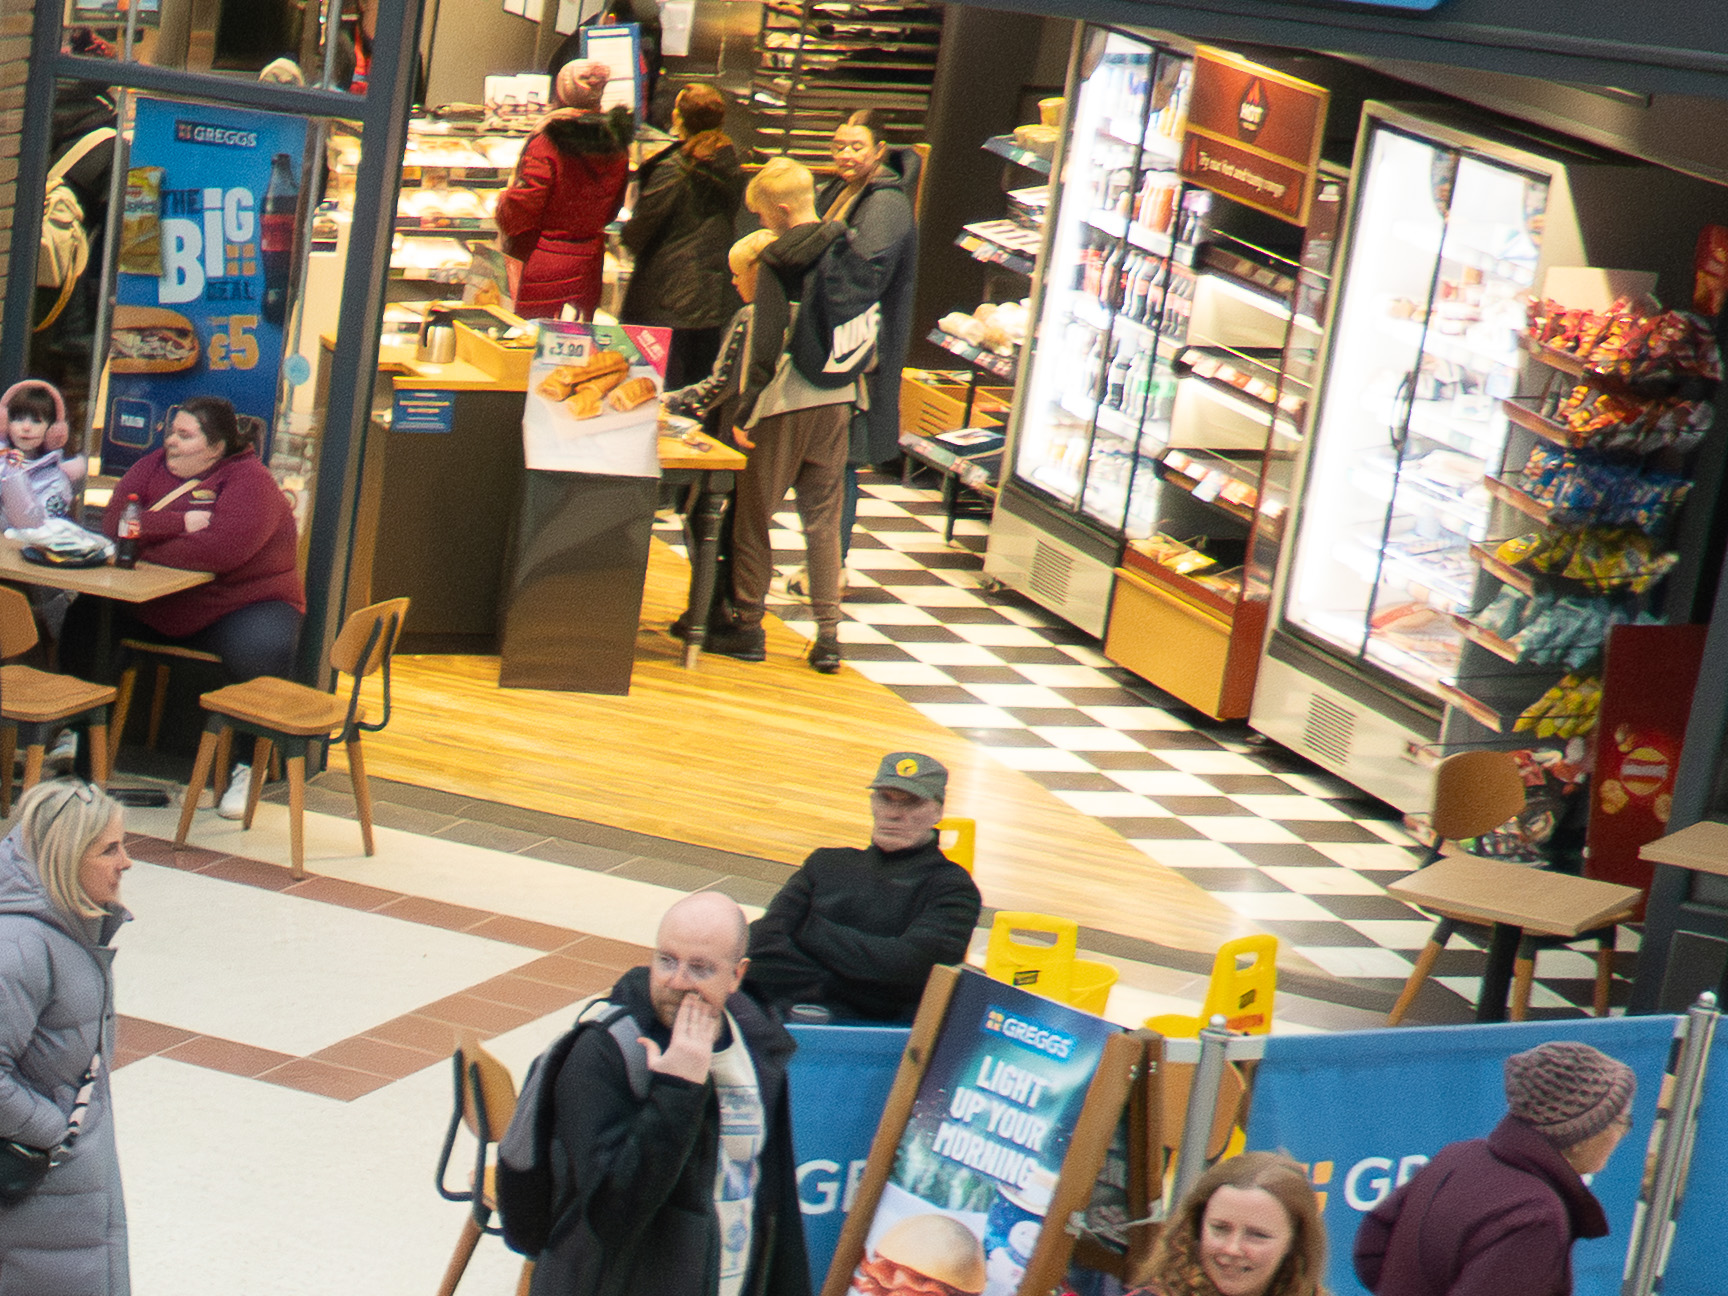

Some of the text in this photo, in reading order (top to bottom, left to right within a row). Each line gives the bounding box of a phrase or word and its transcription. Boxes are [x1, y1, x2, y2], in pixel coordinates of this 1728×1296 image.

[194, 126, 258, 147] GREGGS
[1002, 1017, 1072, 1058] GREGGS
[976, 1055, 1048, 1108] LIGHT
[949, 1087, 1049, 1152] UP YOUR
[932, 1121, 1038, 1191] MORNING
